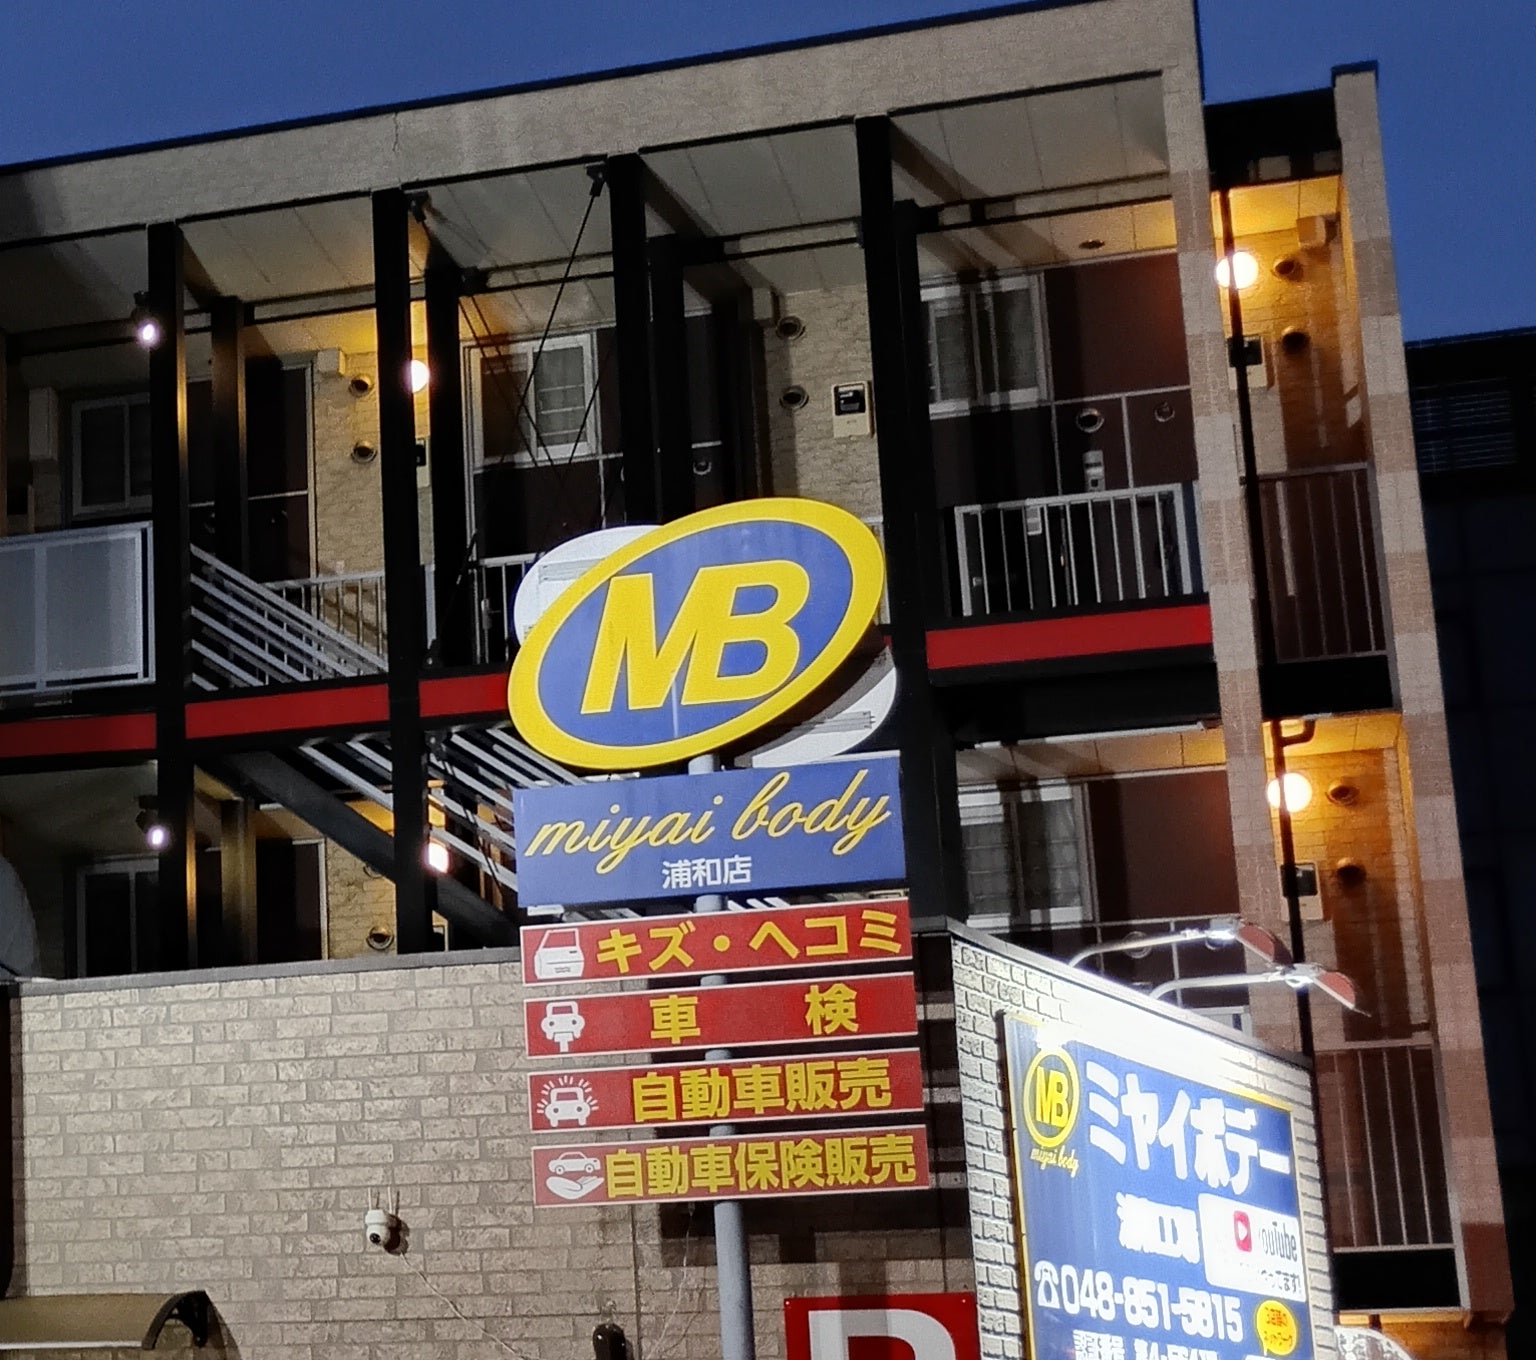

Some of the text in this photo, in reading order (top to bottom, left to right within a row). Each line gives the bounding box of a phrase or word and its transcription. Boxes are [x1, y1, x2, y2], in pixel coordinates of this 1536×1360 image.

[580, 559, 810, 715] MB
[524, 769, 892, 875] miyai body
[661, 855, 753, 890] 浦和店
[595, 909, 903, 974] キズ・ヘコミ
[631, 1057, 893, 1123] 自動車販売
[1035, 1065, 1070, 1128] MB
[604, 1133, 917, 1199] 自動車保険販売
[1060, 1264, 1244, 1343] 048-851-5815
